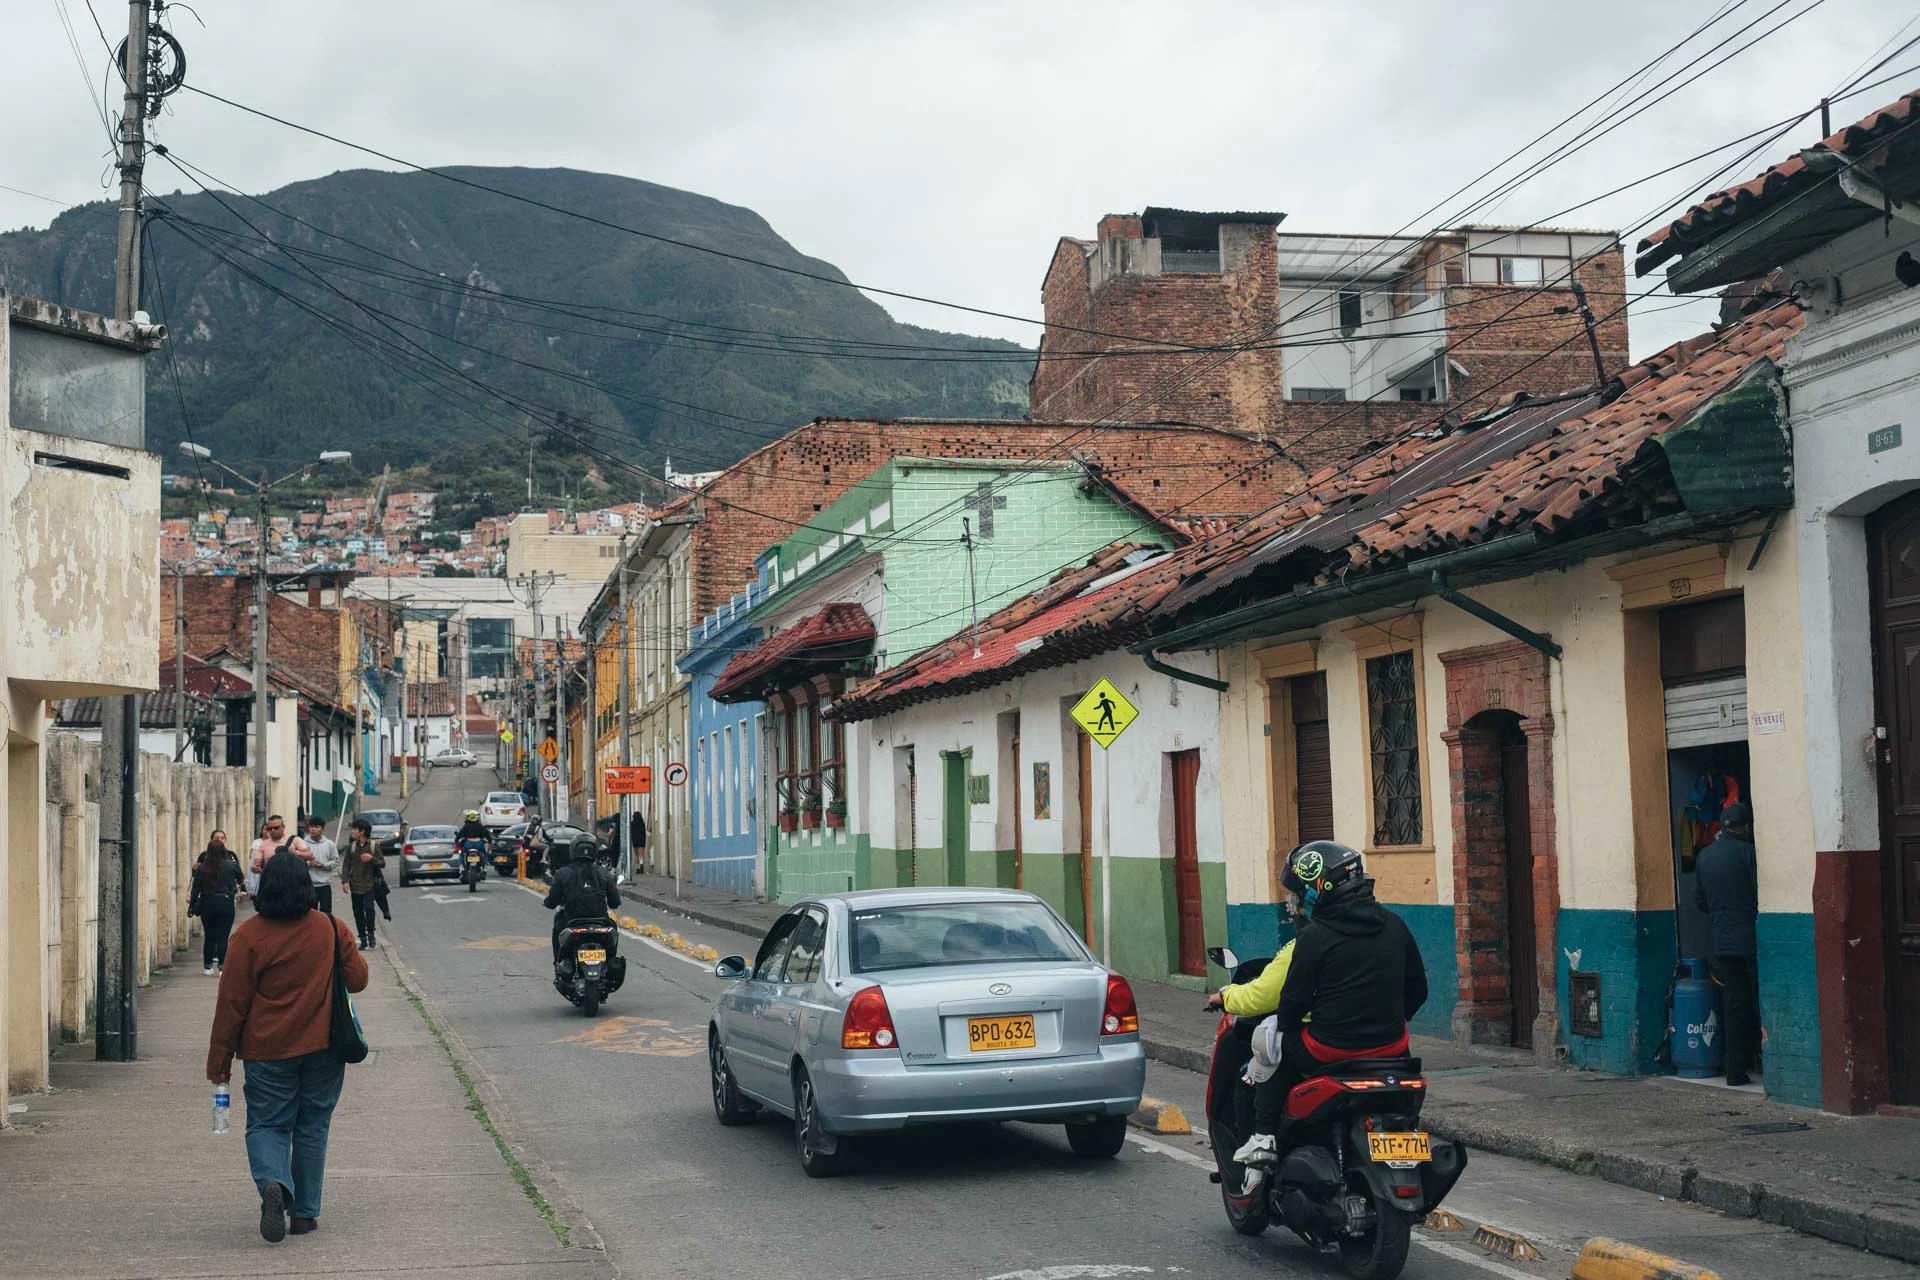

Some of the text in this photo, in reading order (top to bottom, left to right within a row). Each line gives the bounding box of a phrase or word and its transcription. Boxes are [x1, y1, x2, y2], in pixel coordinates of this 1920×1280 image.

[1875, 430, 1894, 448] 8-63
[544, 768, 558, 778] 30
[971, 1021, 1033, 1042] BPO 632
